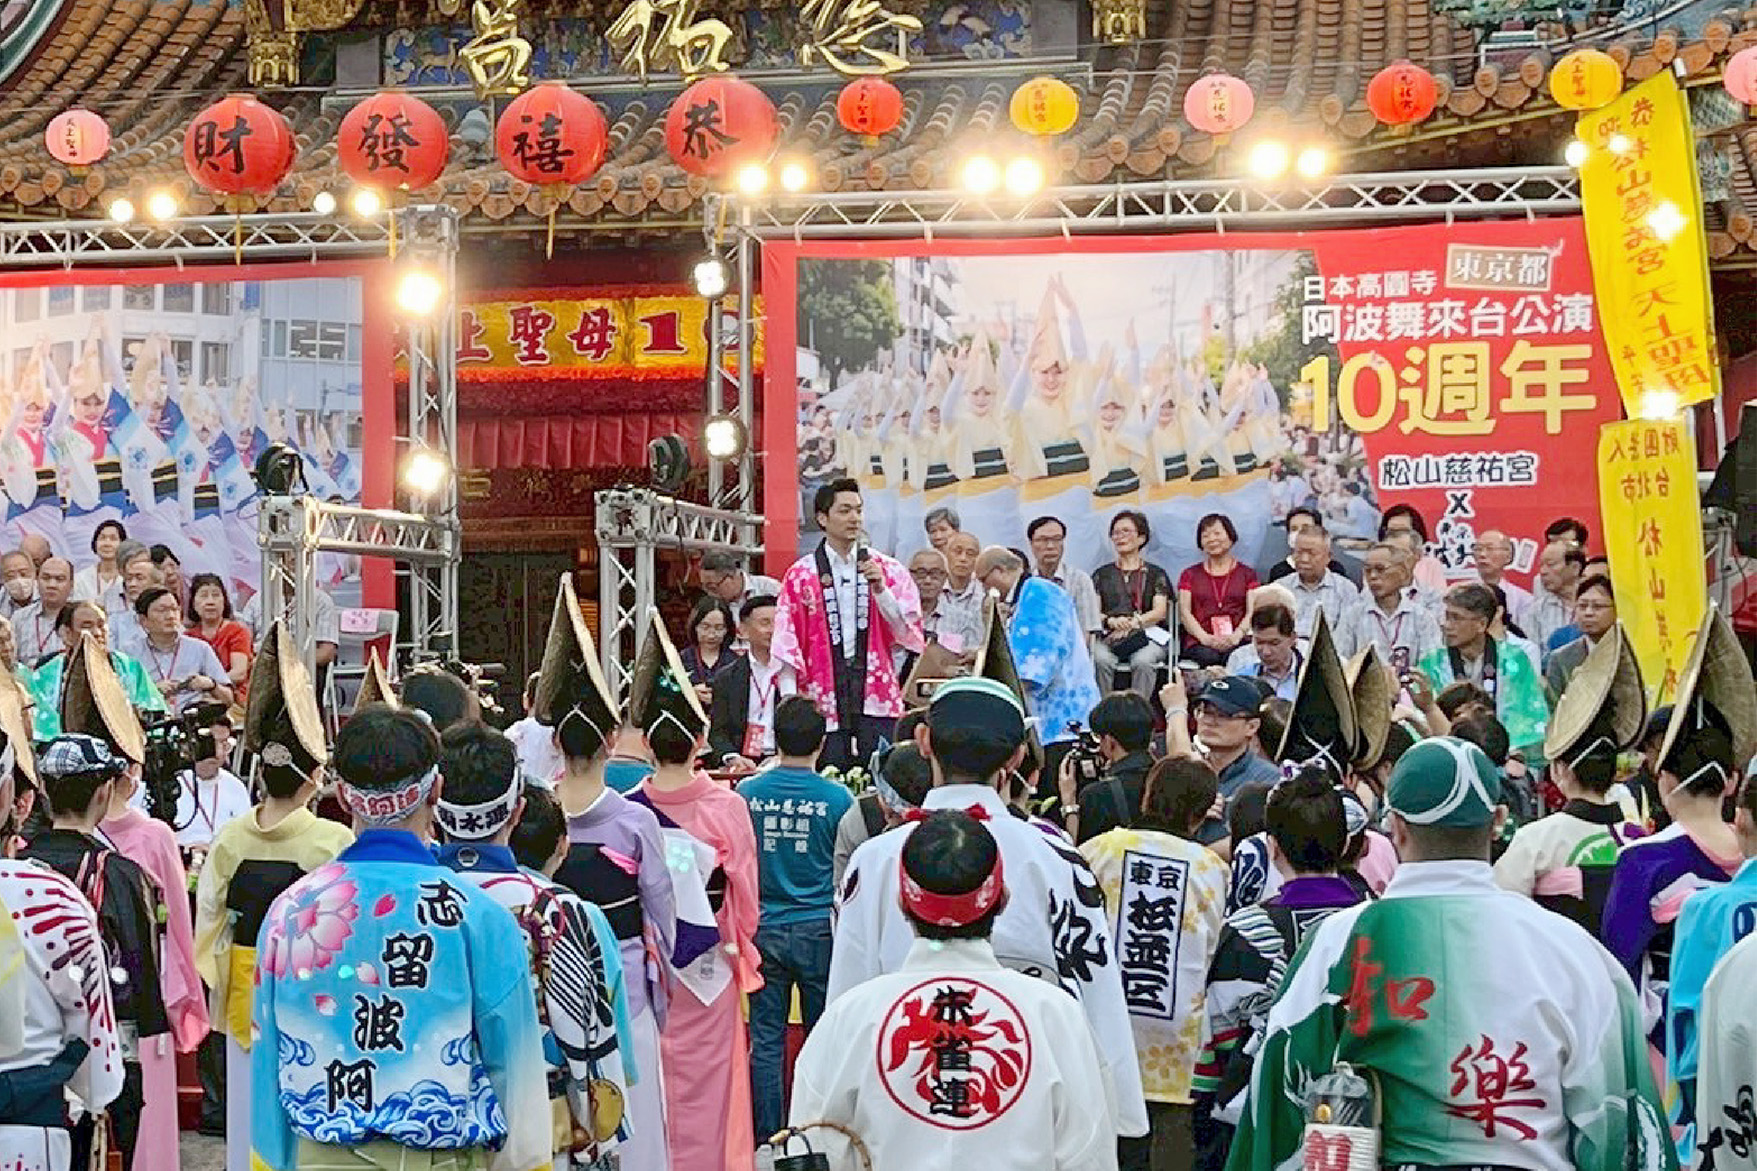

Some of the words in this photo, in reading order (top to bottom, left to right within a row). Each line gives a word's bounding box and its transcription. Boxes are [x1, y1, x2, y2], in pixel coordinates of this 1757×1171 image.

[193, 115, 254, 174] 財
[358, 112, 421, 171] 發
[511, 113, 575, 173] 禧
[681, 103, 739, 156] 恭
[1303, 269, 1438, 302] 日本高圓寺
[1453, 250, 1549, 286] 東京都
[1301, 291, 1595, 345] 阿波舞來台公演
[1299, 339, 1599, 436] 10週年
[1380, 451, 1537, 489] 松山慈祐宮
[1130, 860, 1182, 891] 東京
